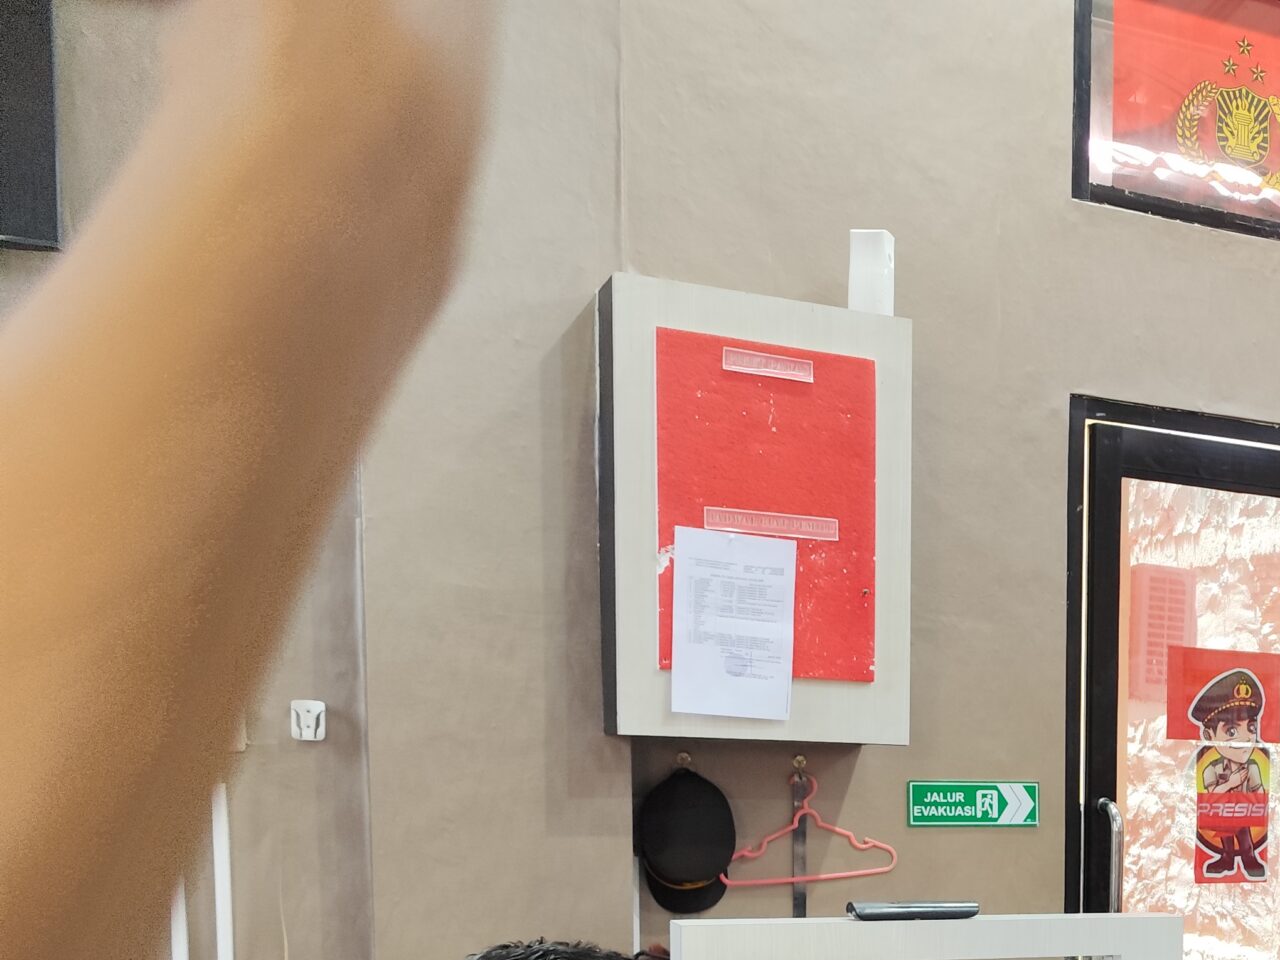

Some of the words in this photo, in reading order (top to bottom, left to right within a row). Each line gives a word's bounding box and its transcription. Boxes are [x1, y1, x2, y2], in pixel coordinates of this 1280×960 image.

[923, 791, 965, 803] JALUR
[913, 805, 976, 817] EVAKUASI
[1197, 802, 1269, 817] PRESISI
